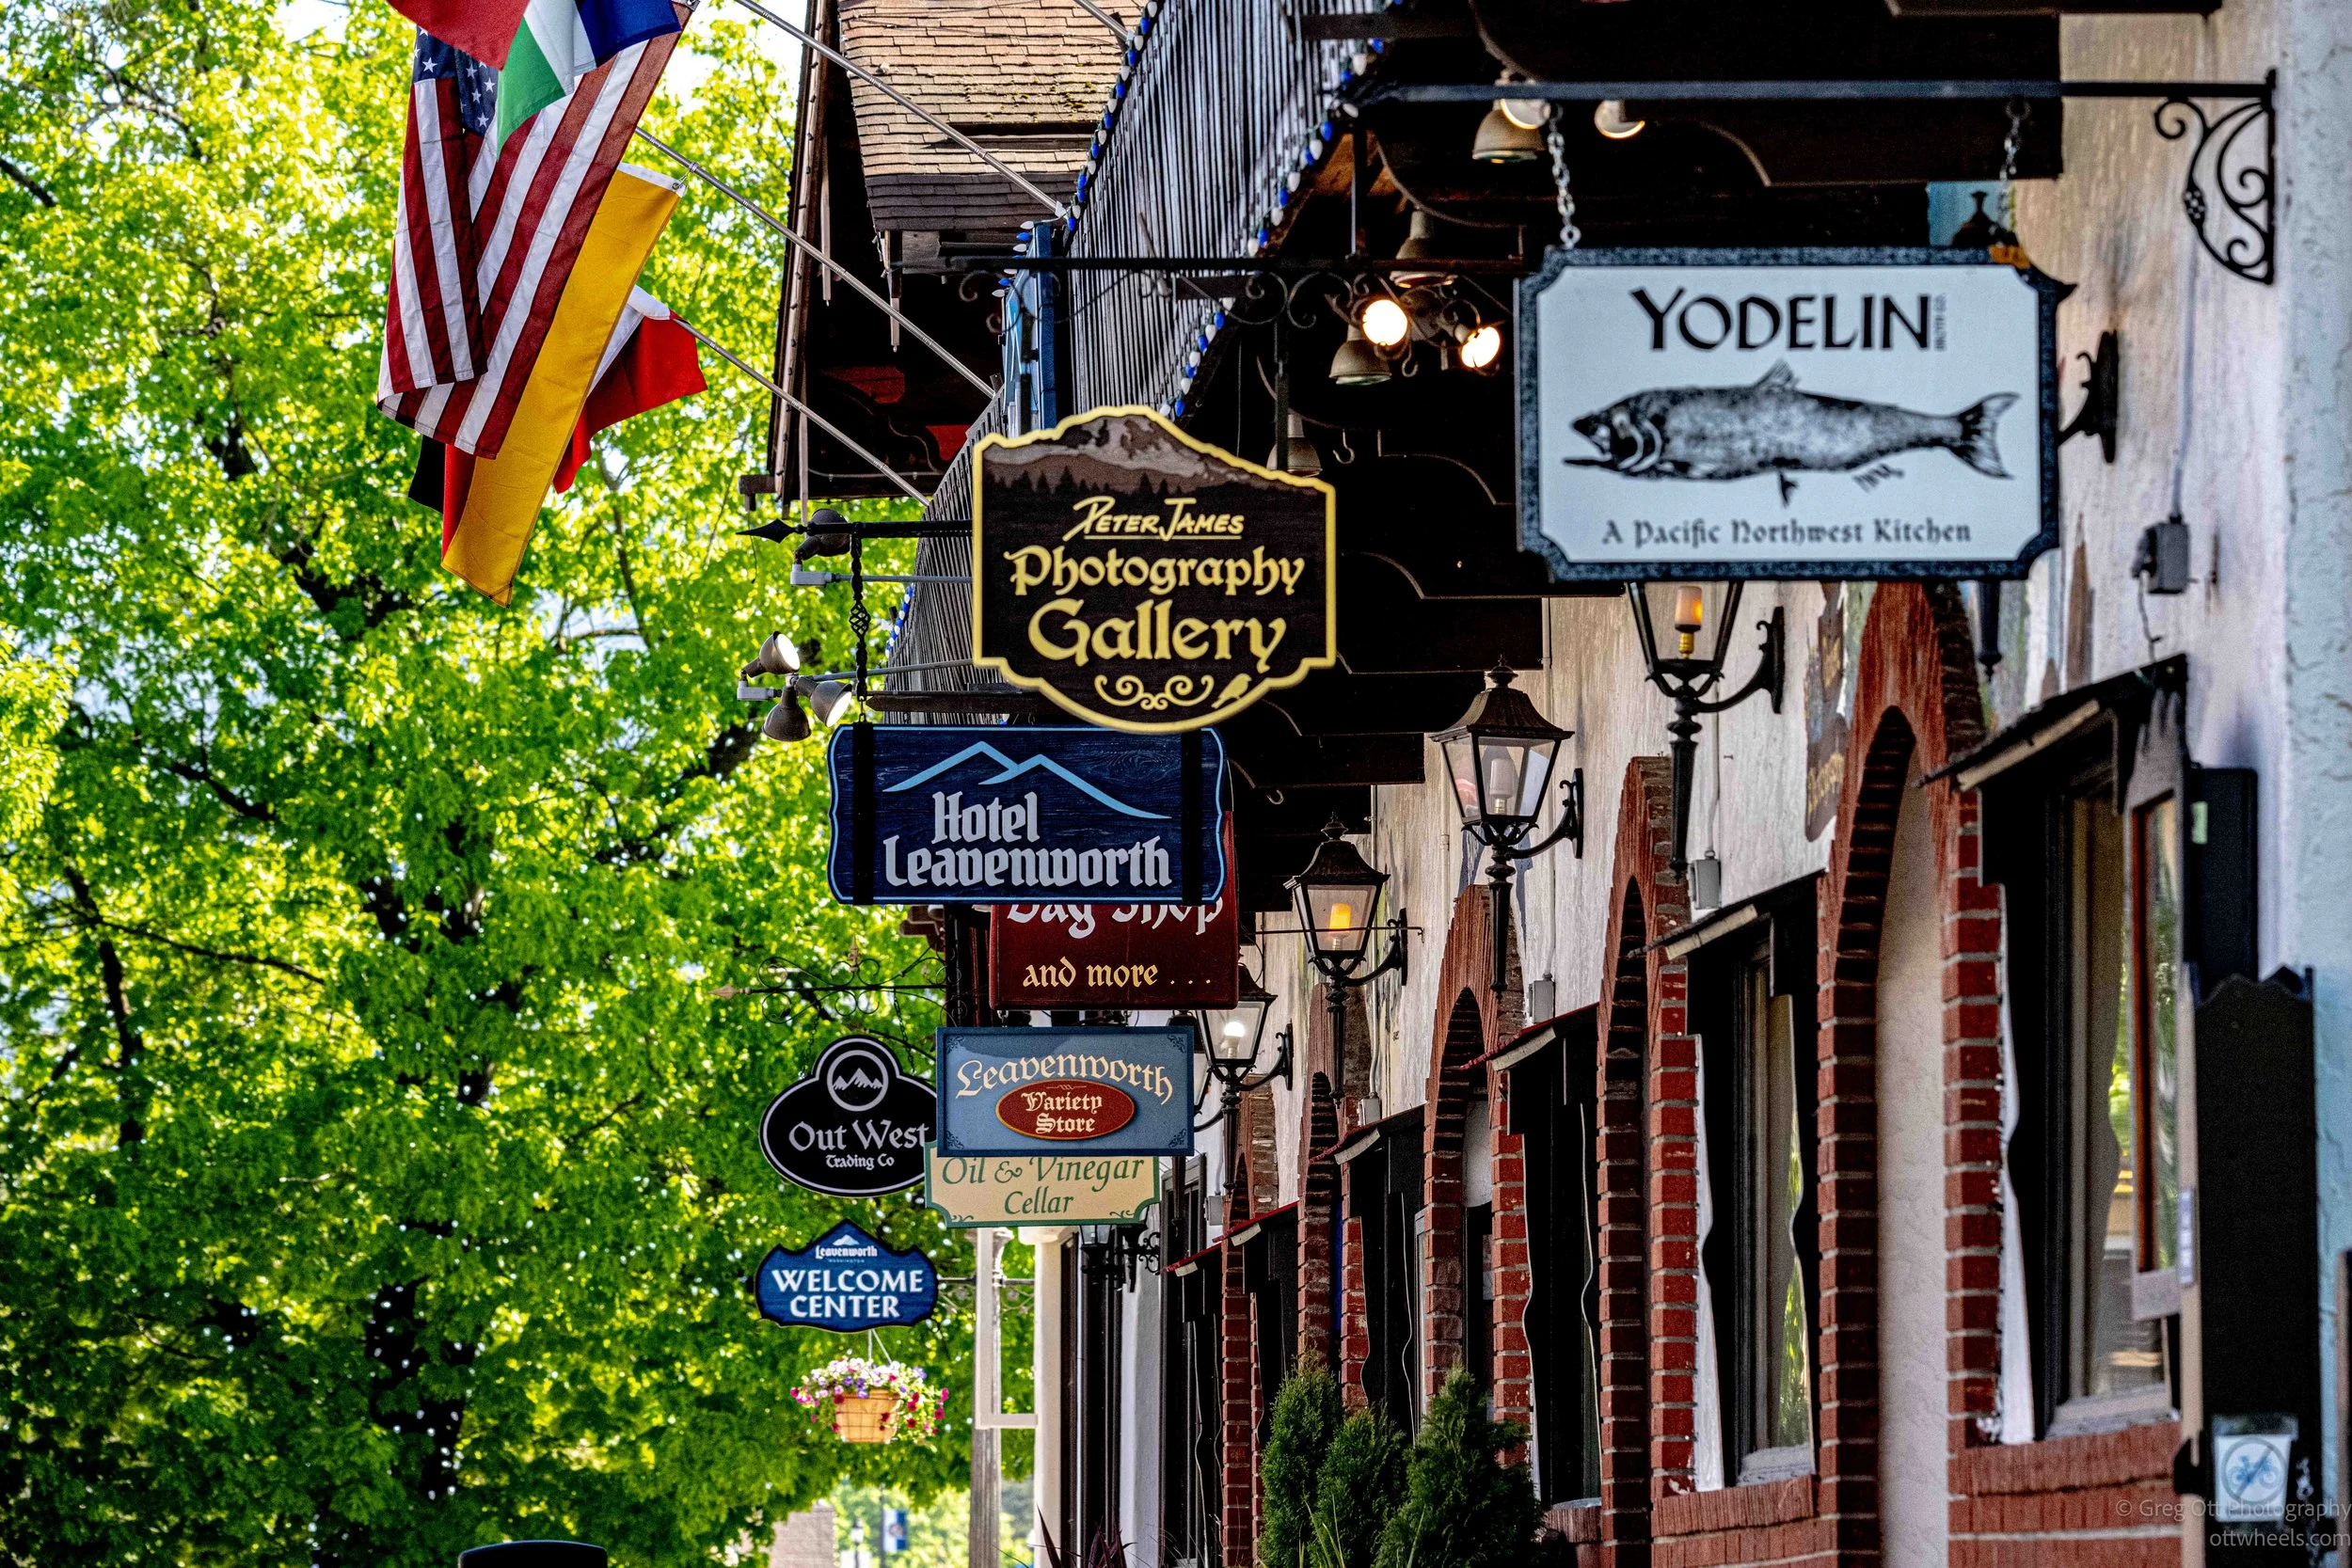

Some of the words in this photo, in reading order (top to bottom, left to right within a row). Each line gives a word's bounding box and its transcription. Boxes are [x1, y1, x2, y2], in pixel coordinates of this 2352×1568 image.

[1629, 286, 1931, 351] YODELIN
[1602, 519, 1623, 545] A
[1634, 518, 1720, 548] Pacific
[1732, 517, 1863, 547] Northwest
[1874, 516, 1971, 546] Kitchen
[1003, 545, 1305, 596] Photography
[1027, 598, 1286, 673] Gallery
[931, 791, 1040, 845] Hotel
[882, 834, 1172, 887] Leavenworth
[1023, 956, 1076, 988] and
[1086, 963, 1158, 988] more
[956, 1053, 1173, 1105] Leavenworth
[1021, 1091, 1104, 1114] Variety
[788, 1121, 848, 1151] Out
[850, 1121, 930, 1150] West
[1035, 1112, 1096, 1134] Store
[825, 1152, 875, 1170] Trading
[878, 1154, 895, 1167] Co
[942, 1157, 986, 1184] Oil
[993, 1161, 1024, 1183] &
[1029, 1157, 1145, 1193] Vinegar
[1004, 1186, 1074, 1214] Cellar
[815, 1244, 878, 1259] Leavenworth
[771, 1269, 923, 1292] WELCOME
[789, 1294, 900, 1318] CENTER
